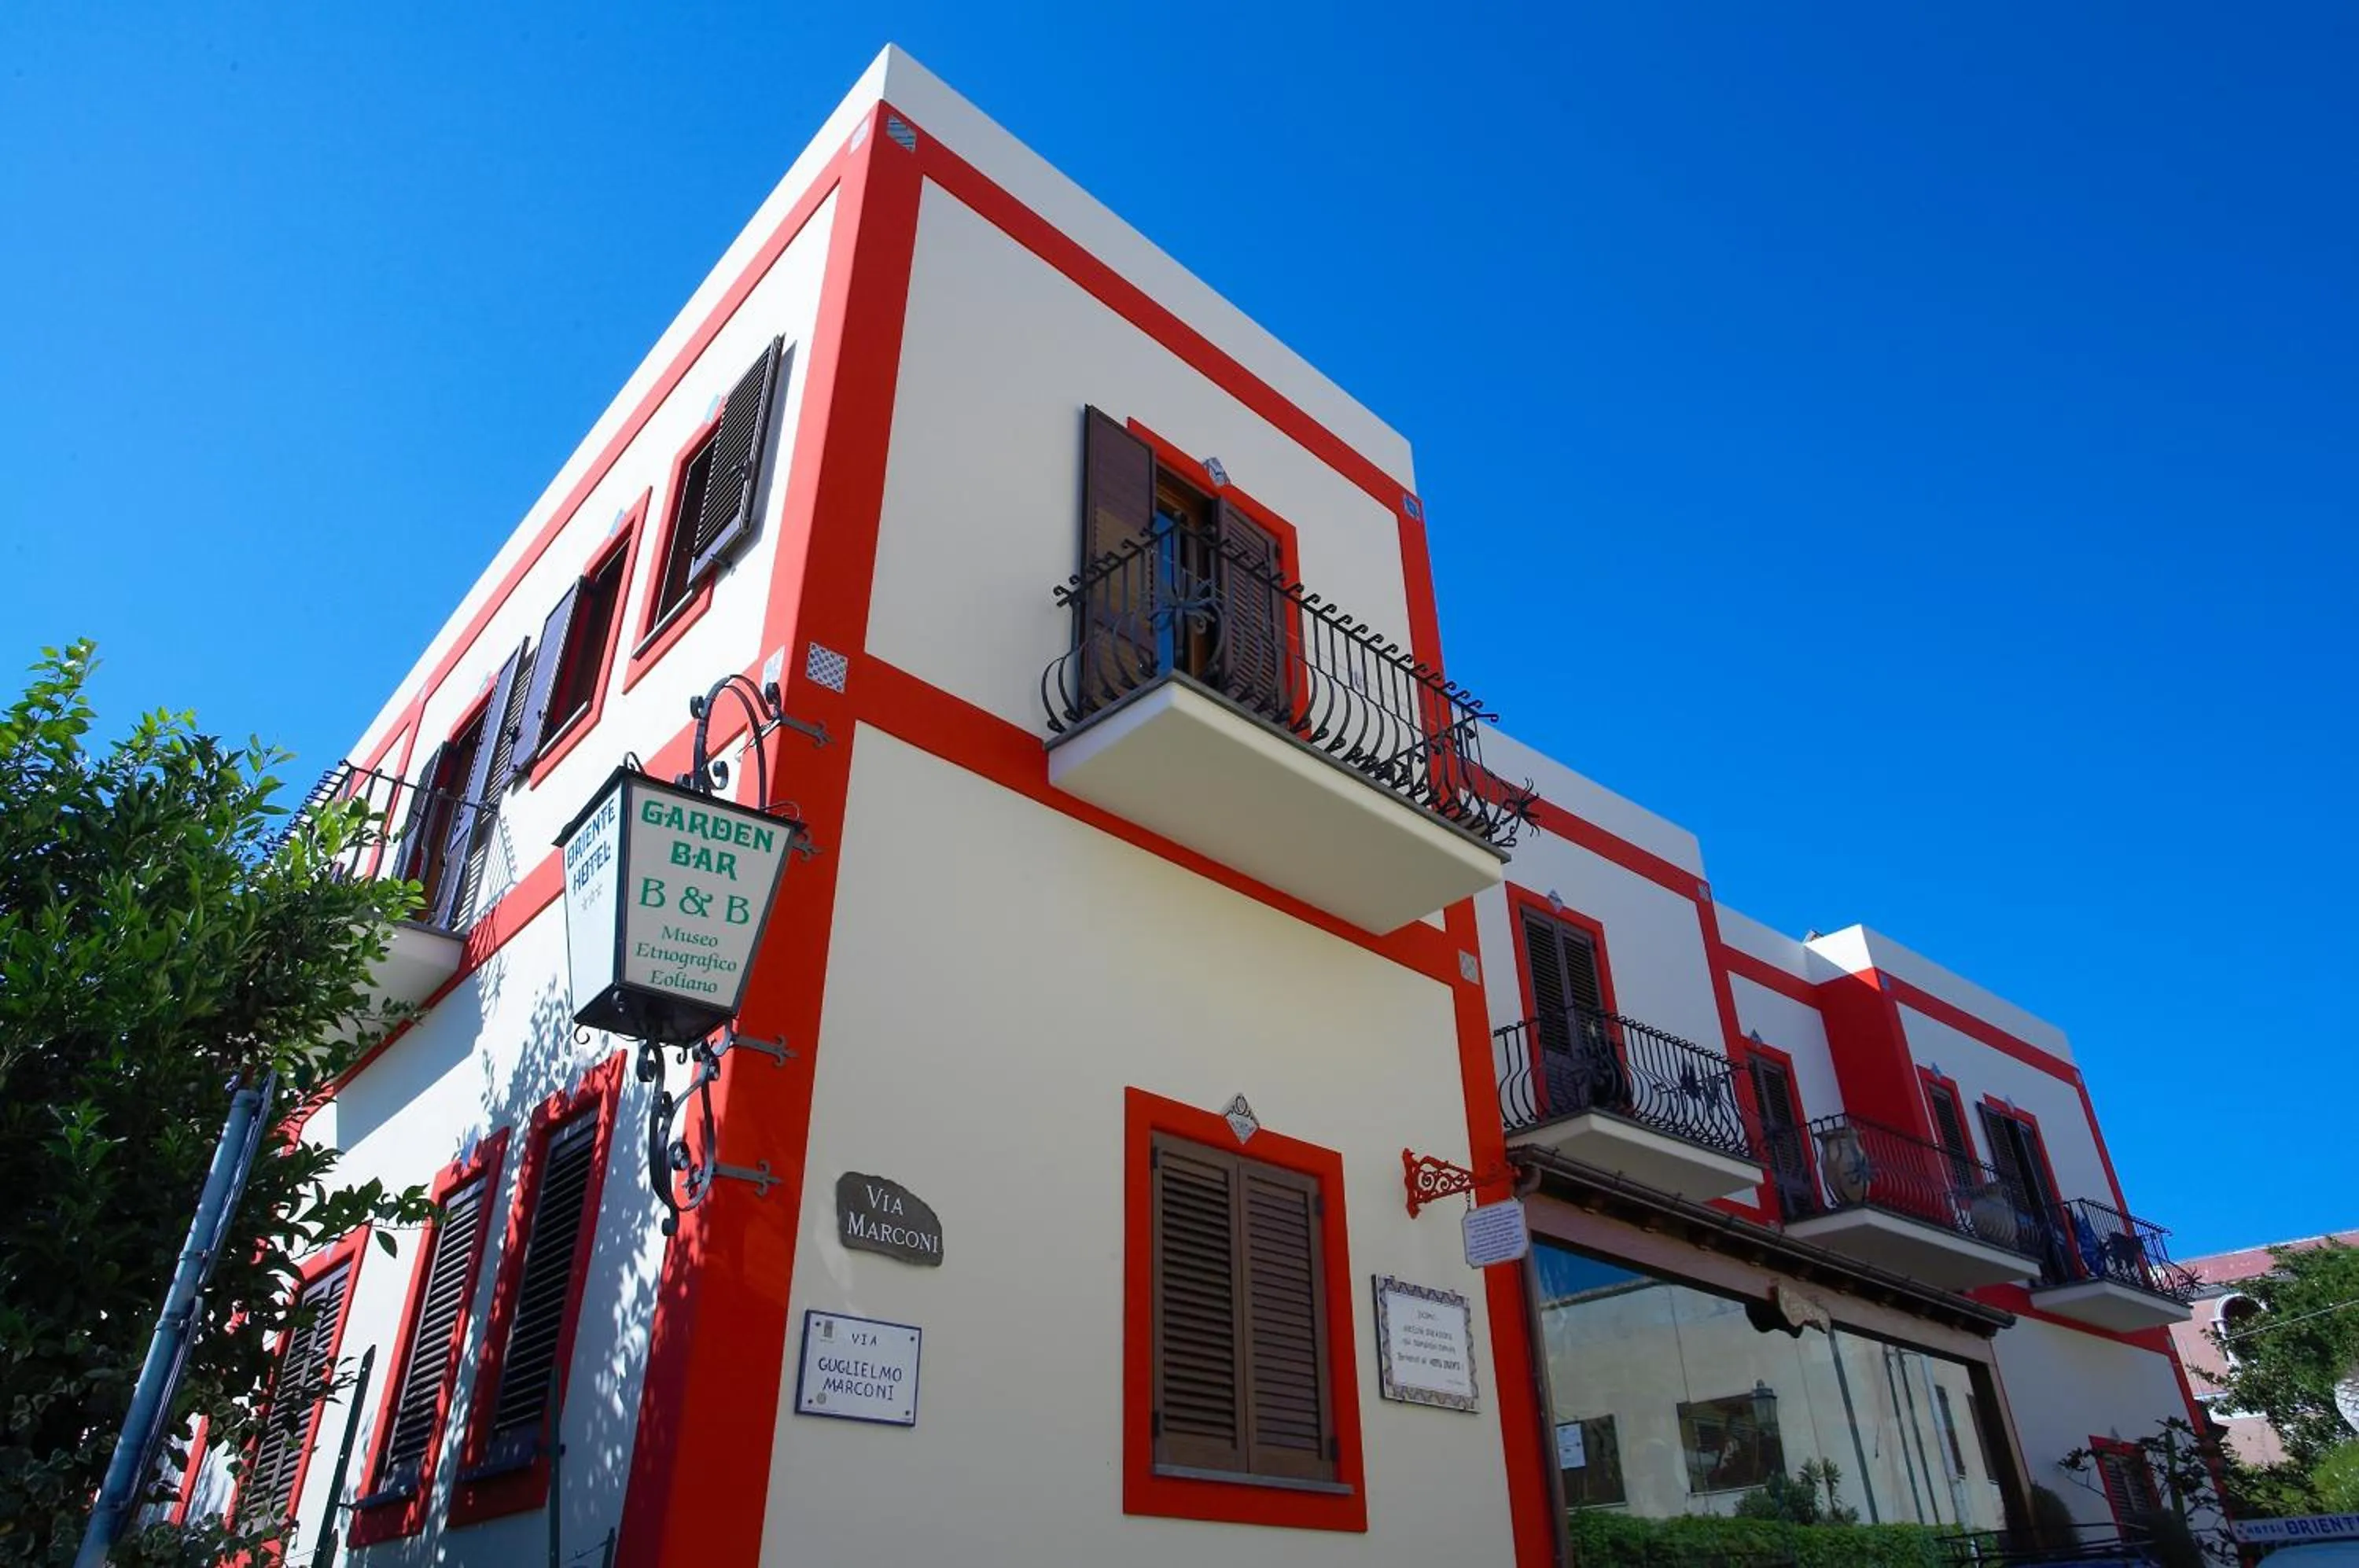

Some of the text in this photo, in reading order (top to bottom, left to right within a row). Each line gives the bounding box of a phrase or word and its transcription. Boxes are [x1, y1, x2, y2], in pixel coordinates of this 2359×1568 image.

[567, 797, 616, 870] ORIENTE
[641, 799, 774, 853] GARDEN
[572, 840, 611, 896] HOTEL
[671, 840, 738, 882] BAR
[639, 877, 750, 926] B & B
[661, 925, 719, 947] Museo
[635, 942, 738, 974] Etnografico
[649, 969, 718, 994] Eoliano
[866, 1184, 903, 1216] VIA
[847, 1211, 939, 1253] MARCONI
[851, 1333, 878, 1346] VIA
[818, 1356, 903, 1382] GUGLIELMO
[823, 1378, 894, 1401] MARCONI
